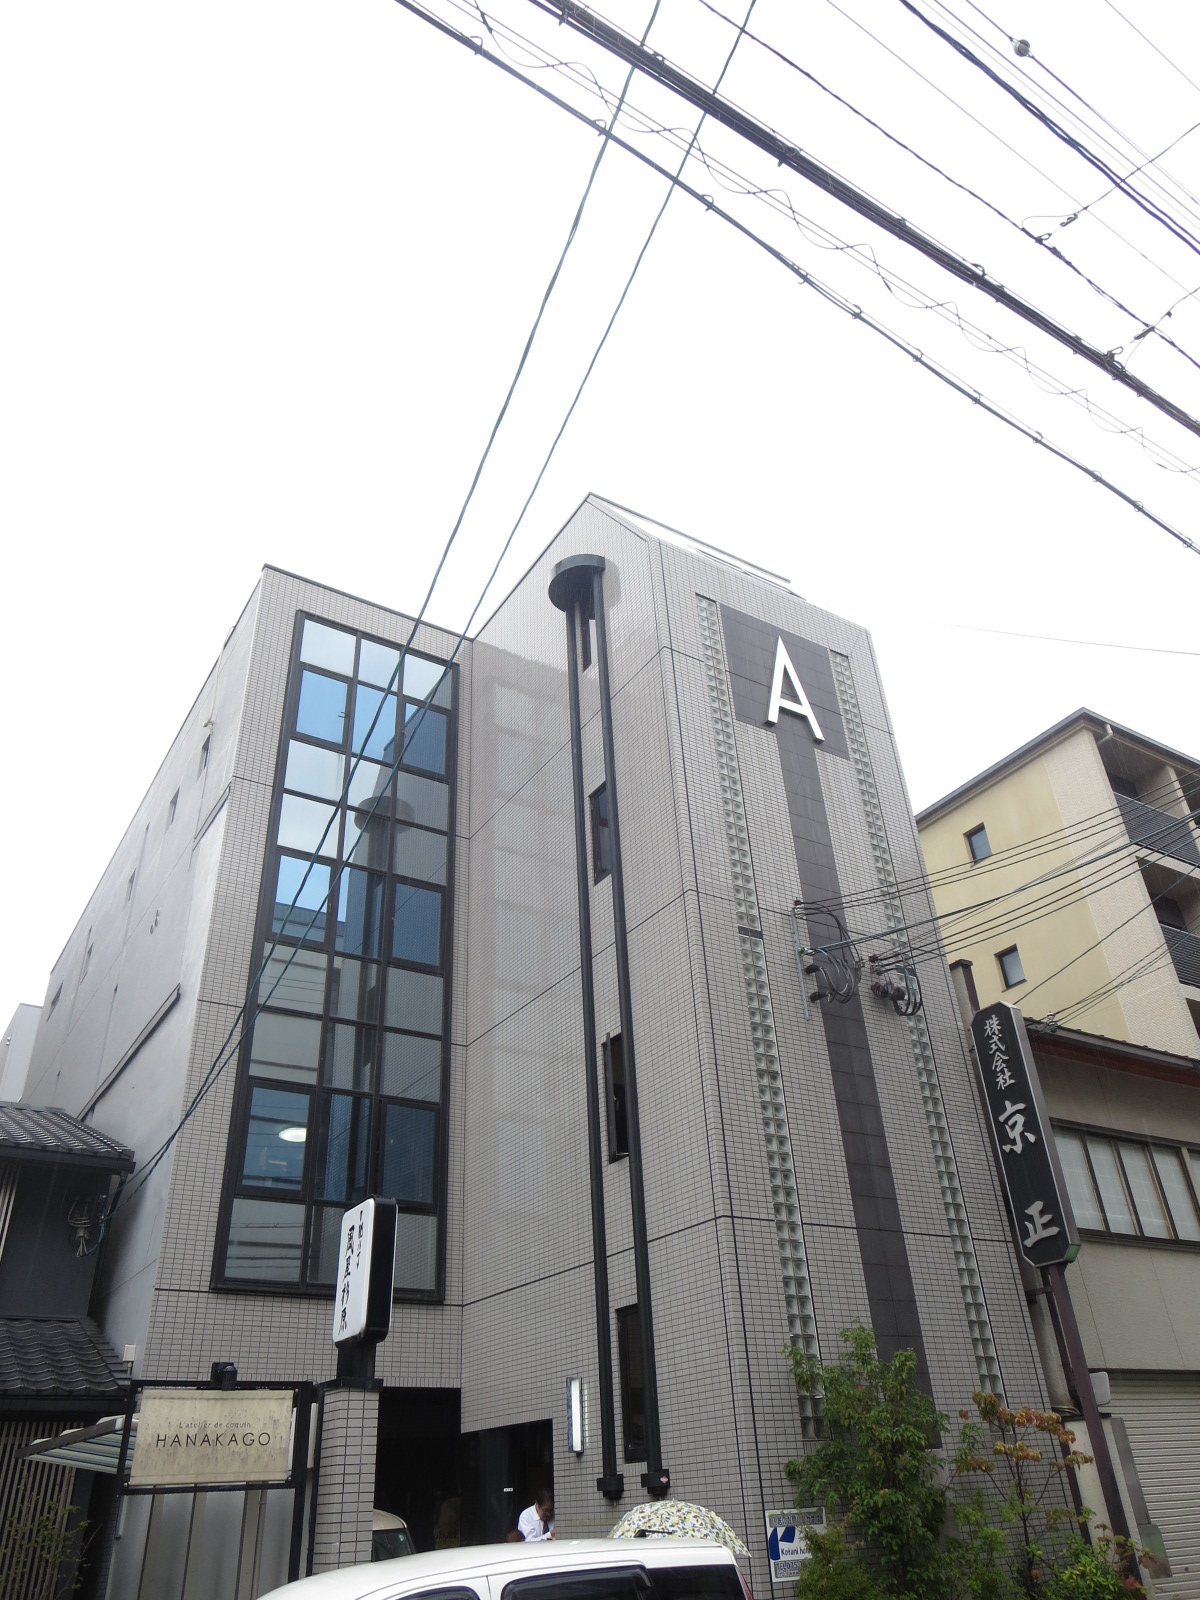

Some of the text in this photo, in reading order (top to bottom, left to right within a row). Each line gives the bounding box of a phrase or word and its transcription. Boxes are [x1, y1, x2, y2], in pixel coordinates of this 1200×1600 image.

[765, 635, 825, 743] A
[984, 1014, 1061, 1248] 株式会社 京正
[156, 1432, 271, 1448] HANAKAGO
